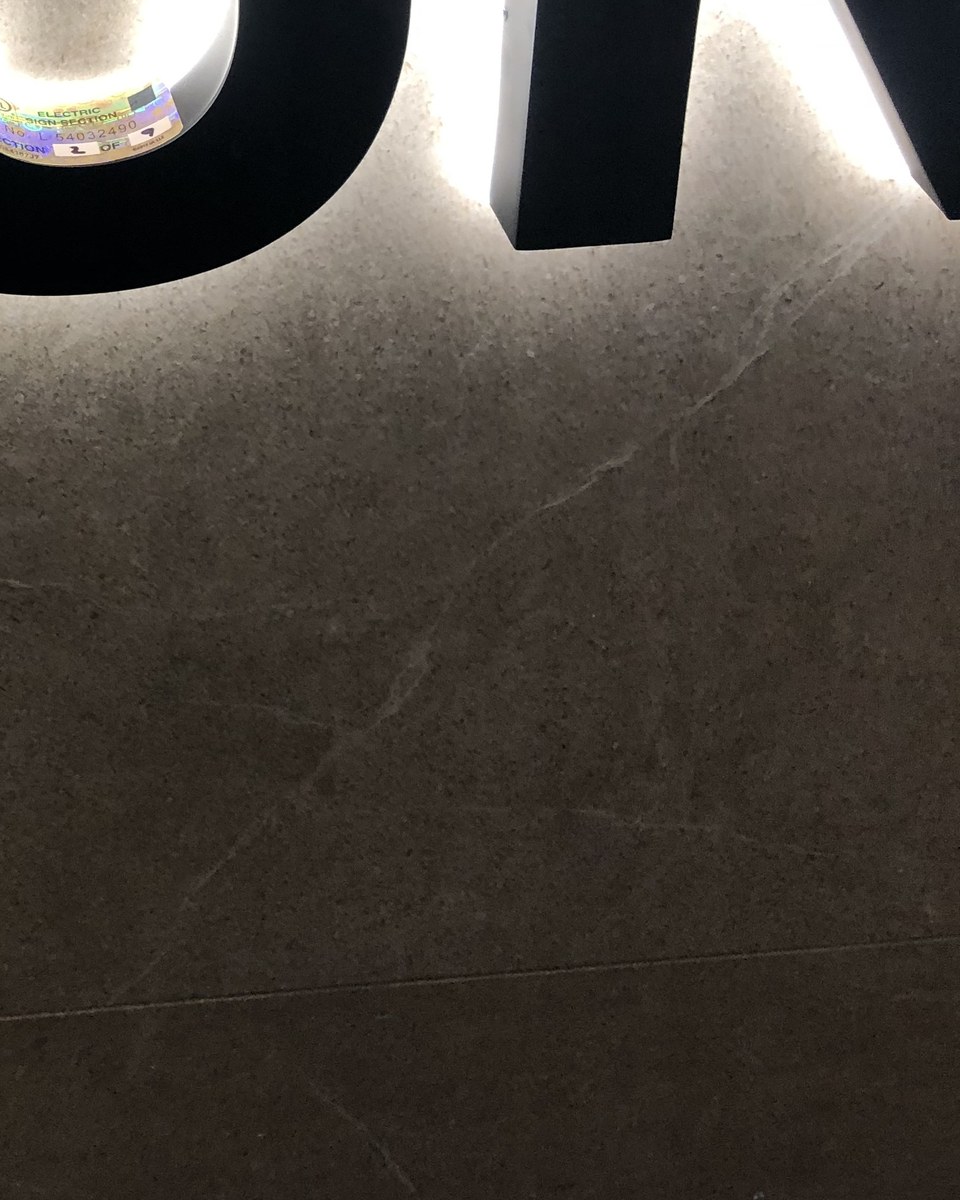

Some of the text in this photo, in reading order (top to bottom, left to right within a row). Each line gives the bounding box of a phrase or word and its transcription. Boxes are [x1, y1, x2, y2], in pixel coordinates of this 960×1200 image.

[37, 107, 101, 118] ELECTRIC
[55, 120, 138, 142] 54032490
[69, 146, 86, 155] 2
[100, 141, 121, 152] OF
